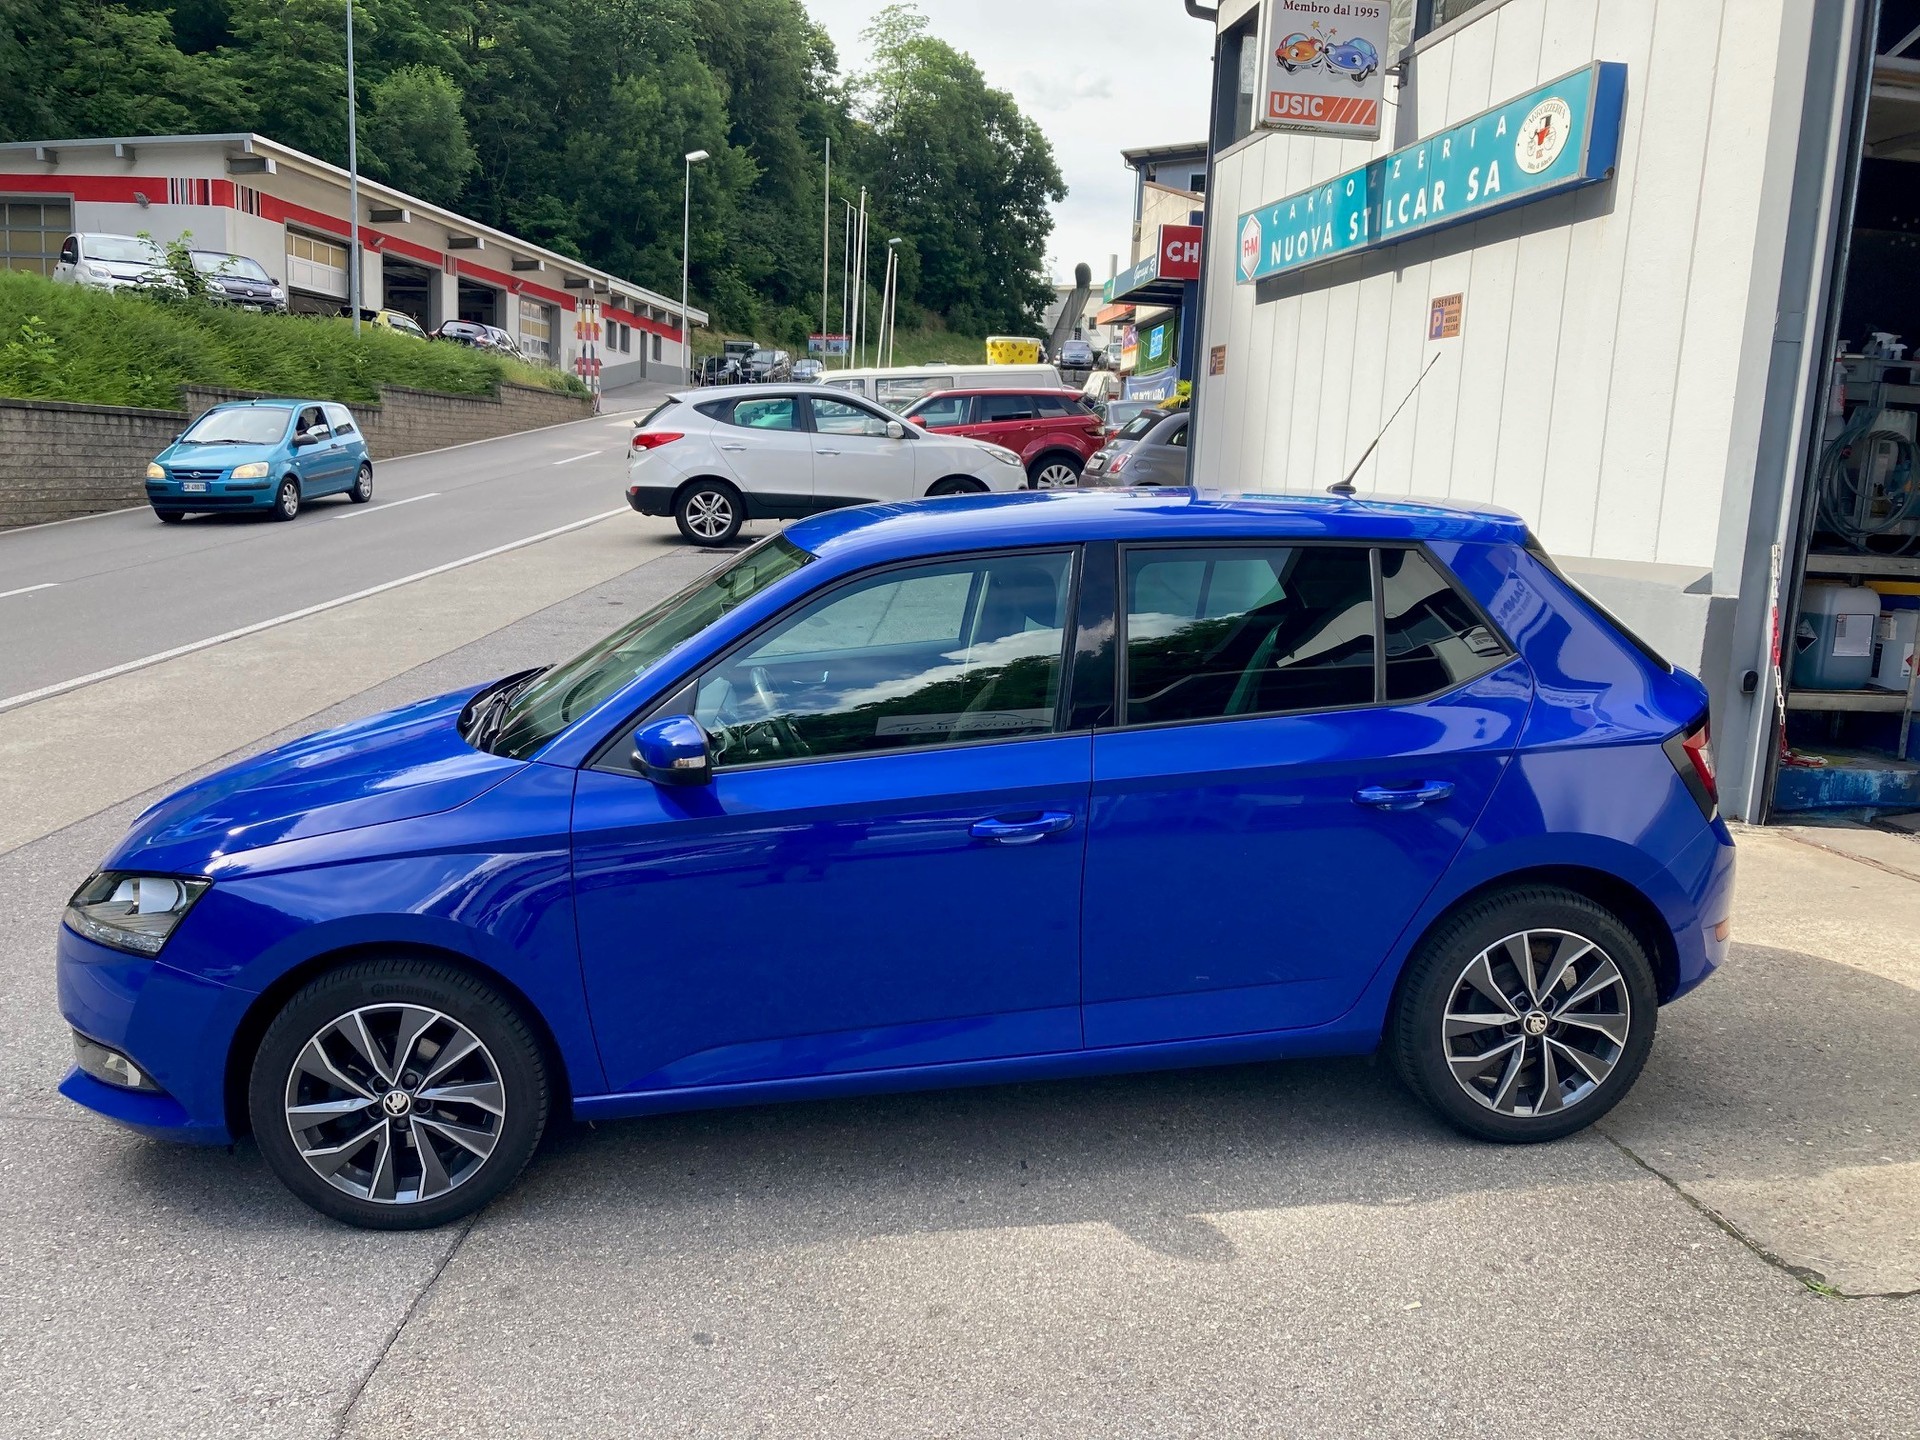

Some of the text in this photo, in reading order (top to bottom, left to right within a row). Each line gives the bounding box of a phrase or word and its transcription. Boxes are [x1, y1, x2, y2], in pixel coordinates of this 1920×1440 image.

[1283, 0, 1379, 18] Membro dal 1995
[1273, 94, 1324, 117] USIC
[1273, 115, 1507, 225] CARROZZERIA
[1271, 160, 1500, 265] NUOVA STILCAR SA
[1166, 241, 1199, 263] CH
